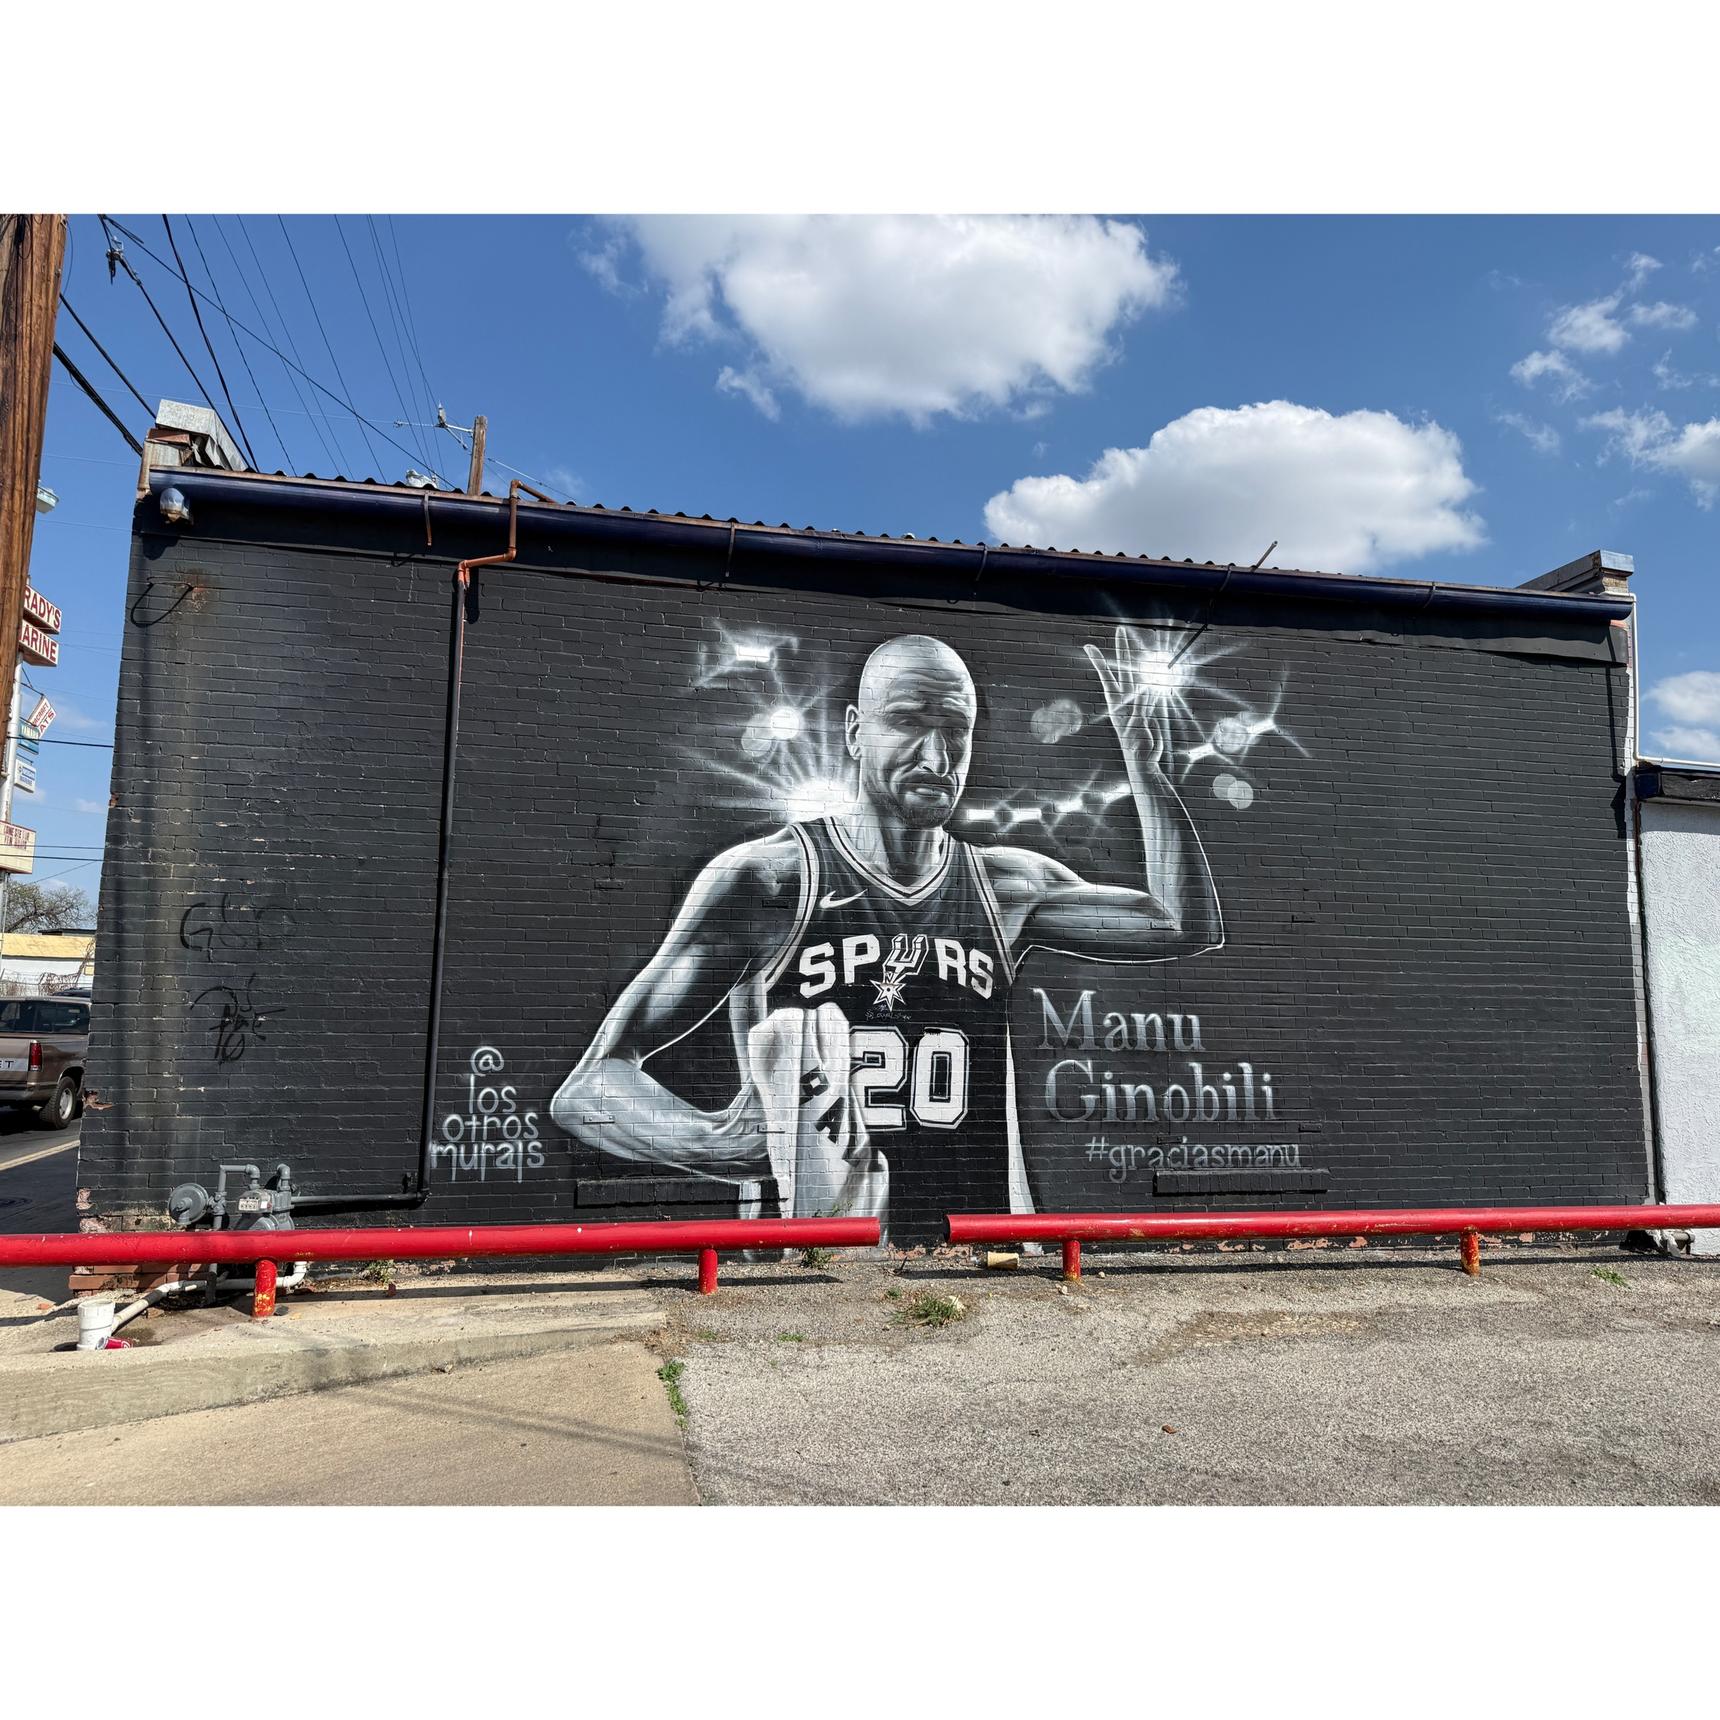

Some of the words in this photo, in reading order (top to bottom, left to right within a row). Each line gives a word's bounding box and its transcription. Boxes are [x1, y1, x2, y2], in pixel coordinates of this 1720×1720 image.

[23, 586, 61, 629] RADY'S
[798, 932, 995, 1000] SPURS
[1032, 987, 1206, 1052] Manu
[0, 1060, 15, 1069] T
[470, 1045, 504, 1077] @
[849, 1025, 970, 1131] 20
[468, 1073, 517, 1114] los
[1045, 1058, 1279, 1122] Ginobili
[442, 1111, 539, 1142] otros
[430, 1140, 545, 1183] murals
[1085, 1135, 1302, 1184] #graciasmanu
